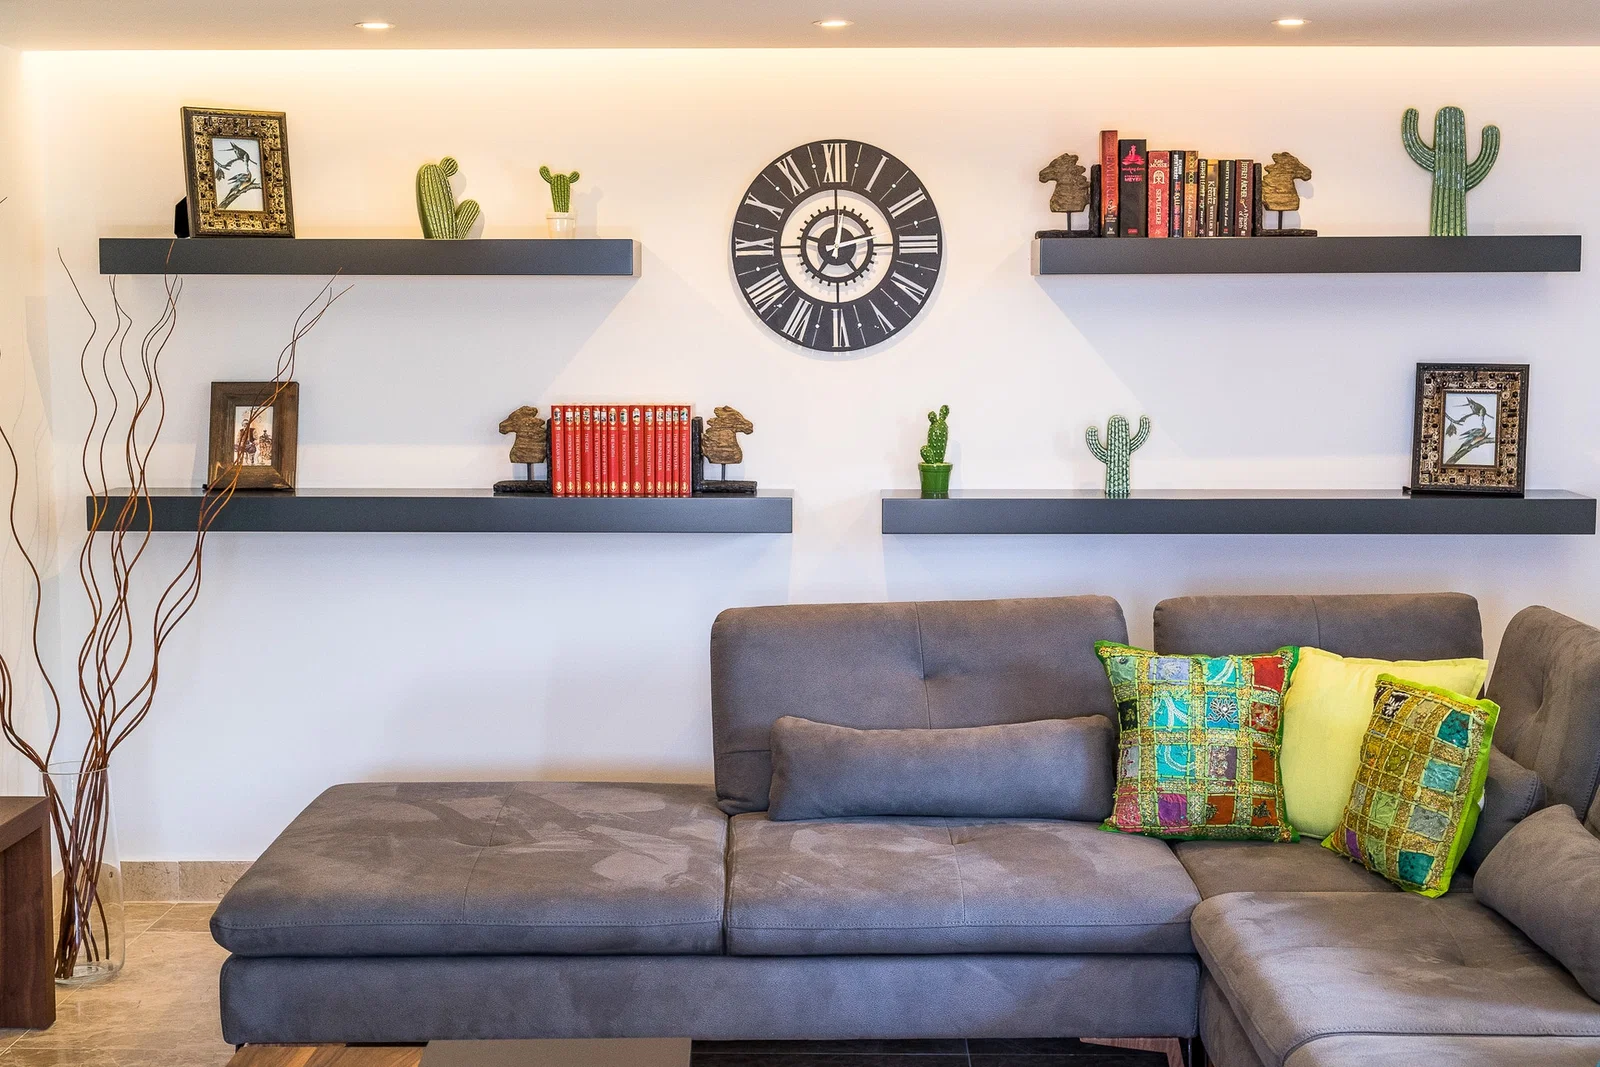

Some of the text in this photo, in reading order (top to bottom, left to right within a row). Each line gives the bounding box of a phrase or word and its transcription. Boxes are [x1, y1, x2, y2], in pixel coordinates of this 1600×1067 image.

[774, 154, 810, 196] XI
[822, 143, 848, 183] XII
[864, 155, 889, 193] I
[744, 193, 784, 220] X
[887, 187, 927, 220] II
[735, 237, 774, 257] IX
[899, 233, 939, 255] III
[745, 269, 789, 314] VIII
[890, 271, 928, 305] IV
[782, 297, 814, 342] VII
[831, 308, 850, 347] VI
[869, 300, 895, 334] V
